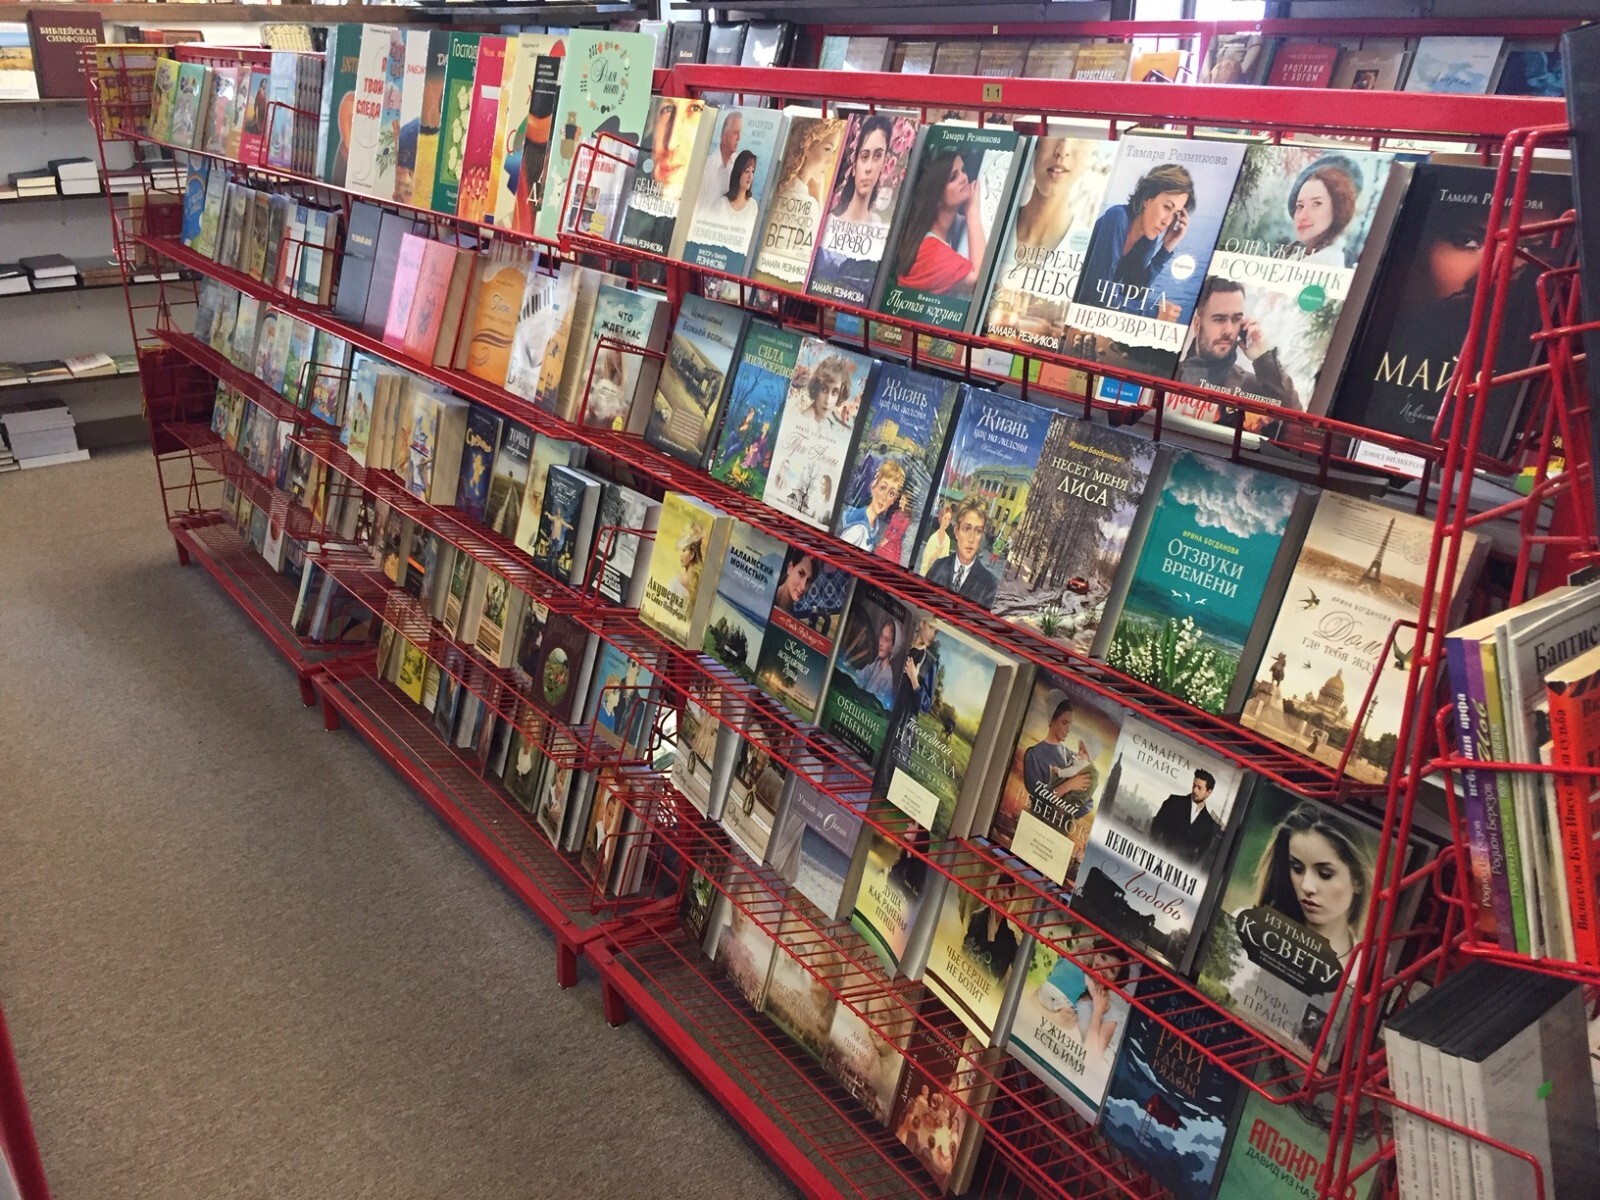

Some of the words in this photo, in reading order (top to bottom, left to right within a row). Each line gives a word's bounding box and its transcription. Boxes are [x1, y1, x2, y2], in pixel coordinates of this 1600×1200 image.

[40, 26, 97, 35] БИБЛЕЙСКАЯ
[46, 35, 97, 43] СИМФОНИЯ
[452, 39, 478, 62] Господ
[590, 57, 617, 83] Для
[1282, 64, 1324, 73] ПРОГУЛКИ
[1291, 73, 1318, 82] БОГОМ
[364, 78, 384, 95] ТВОИ
[356, 100, 380, 119] СЛЕДА
[942, 130, 965, 141] Тамара
[966, 132, 1001, 144] Резникова
[1126, 144, 1165, 161] Тамара
[1167, 149, 1228, 166] Резникова
[633, 195, 676, 215] СТРАНИЦЫ
[773, 211, 813, 228] ПОПУТНОГО
[777, 195, 812, 215] ПРОТИВ
[622, 236, 637, 246] ТАМАРА
[638, 240, 664, 253] РЕЗНИКОВА
[765, 223, 813, 252] ВЕТРА
[828, 218, 883, 240] АБРИКОСОВОЕ
[1014, 244, 1083, 273] ОЧЕРЕДЬ
[1224, 237, 1319, 264] ОДНАЖДЫ
[761, 258, 780, 269] ТАМАРА
[781, 261, 806, 277] РЕЗНИКО
[1228, 258, 1345, 291] СОЧЕЛЬНИК
[812, 281, 832, 294] ТАМАРА
[833, 285, 864, 303] РЕЗНИКОВА
[886, 289, 924, 315] Пустая
[926, 304, 963, 325] корзина
[1096, 279, 1167, 313] ЧЕРТА
[601, 319, 625, 335] ЖДЕТ
[626, 328, 642, 341] НАС
[618, 310, 634, 324] ЧТО
[1074, 307, 1179, 344] НЕВОЗВРАТА
[988, 322, 1016, 339] ТАМАРА
[1016, 330, 1059, 349] РЕЗНИКОВ
[744, 353, 793, 380] МИЛОСЕРДИЯ
[758, 344, 785, 364] СИЛА
[881, 376, 928, 410] Жизнь
[1200, 378, 1231, 395] Тамара
[1233, 386, 1281, 407] Резникова
[891, 403, 901, 412] на
[901, 406, 927, 421] ладони
[976, 405, 1030, 440] Жизнь
[1400, 402, 1437, 423] Повест
[987, 433, 998, 443] на
[998, 437, 1028, 454] ладони
[1057, 475, 1108, 508] ЛИСА
[1091, 469, 1130, 492] МЕНЯ
[1182, 529, 1203, 544] ИРИНА
[1203, 536, 1239, 556] БОГДАНОВА
[730, 546, 774, 577] ВАЛААМСКИЙ
[730, 557, 769, 584] МОНАСТЫРЬ
[647, 575, 684, 609] Акушерка
[1161, 557, 1238, 599] ВРЕМЕНИ
[651, 594, 687, 623] Санкт-Петербурга
[1331, 595, 1353, 608] ИРИНА
[1354, 604, 1393, 623] БОГДАНОВА
[1302, 635, 1321, 652] где
[1323, 643, 1348, 662] тебя
[1353, 654, 1387, 676] жду
[1533, 620, 1600, 675] Баптис
[837, 694, 881, 737] ОБЕЩАНИЕ
[1457, 693, 1470, 730] арфа
[838, 710, 873, 745] РЕБЕККИ
[906, 716, 953, 756] Последняя
[1556, 708, 1571, 751] судьба
[892, 748, 925, 776] САМАНТА
[895, 726, 957, 780] НАДЕЖДА
[1132, 732, 1191, 771] САМАНТА
[1136, 750, 1180, 779] ПРАЙС
[1035, 779, 1080, 817] Тайный
[1484, 783, 1498, 831] Березов
[1565, 791, 1578, 830] Иисус
[1015, 787, 1089, 845] РЕБЕНОК
[1104, 828, 1198, 897] НЕПОСТИЖИМАЯ
[1490, 833, 1503, 875] Родион
[1104, 860, 1186, 921] Любовь
[1479, 871, 1492, 908] Родион
[1577, 864, 1589, 932] Вильгельм
[868, 884, 881, 904] КАК
[881, 897, 909, 932] РАНЕНАЯ
[874, 906, 897, 936] ПТИЦА
[1264, 912, 1283, 930] ИЗ
[1284, 921, 1323, 954] ТЬМЫ
[1241, 915, 1261, 948] К
[1261, 930, 1340, 985] СВЕТУ
[945, 961, 958, 979] НЕ
[957, 971, 985, 1005] БОЛИТ
[946, 945, 962, 967] ЧЬЕ
[961, 957, 993, 996] СЕРДЦЕ
[1253, 985, 1290, 1016] РУФЬ
[1033, 1029, 1060, 1055] ЕСТЬ
[1059, 1046, 1086, 1077] ИМЯ
[1039, 1016, 1048, 1028] У
[1047, 1022, 1088, 1061] ЖИЗНИ
[1152, 1059, 1198, 1100] РЯДОМ
[1246, 1146, 1282, 1178] ДАВИД
[1281, 1173, 1295, 1188] ИЗ
[1295, 1181, 1321, 1200] НАЗ
[1248, 1118, 1358, 1200] АПОКР
